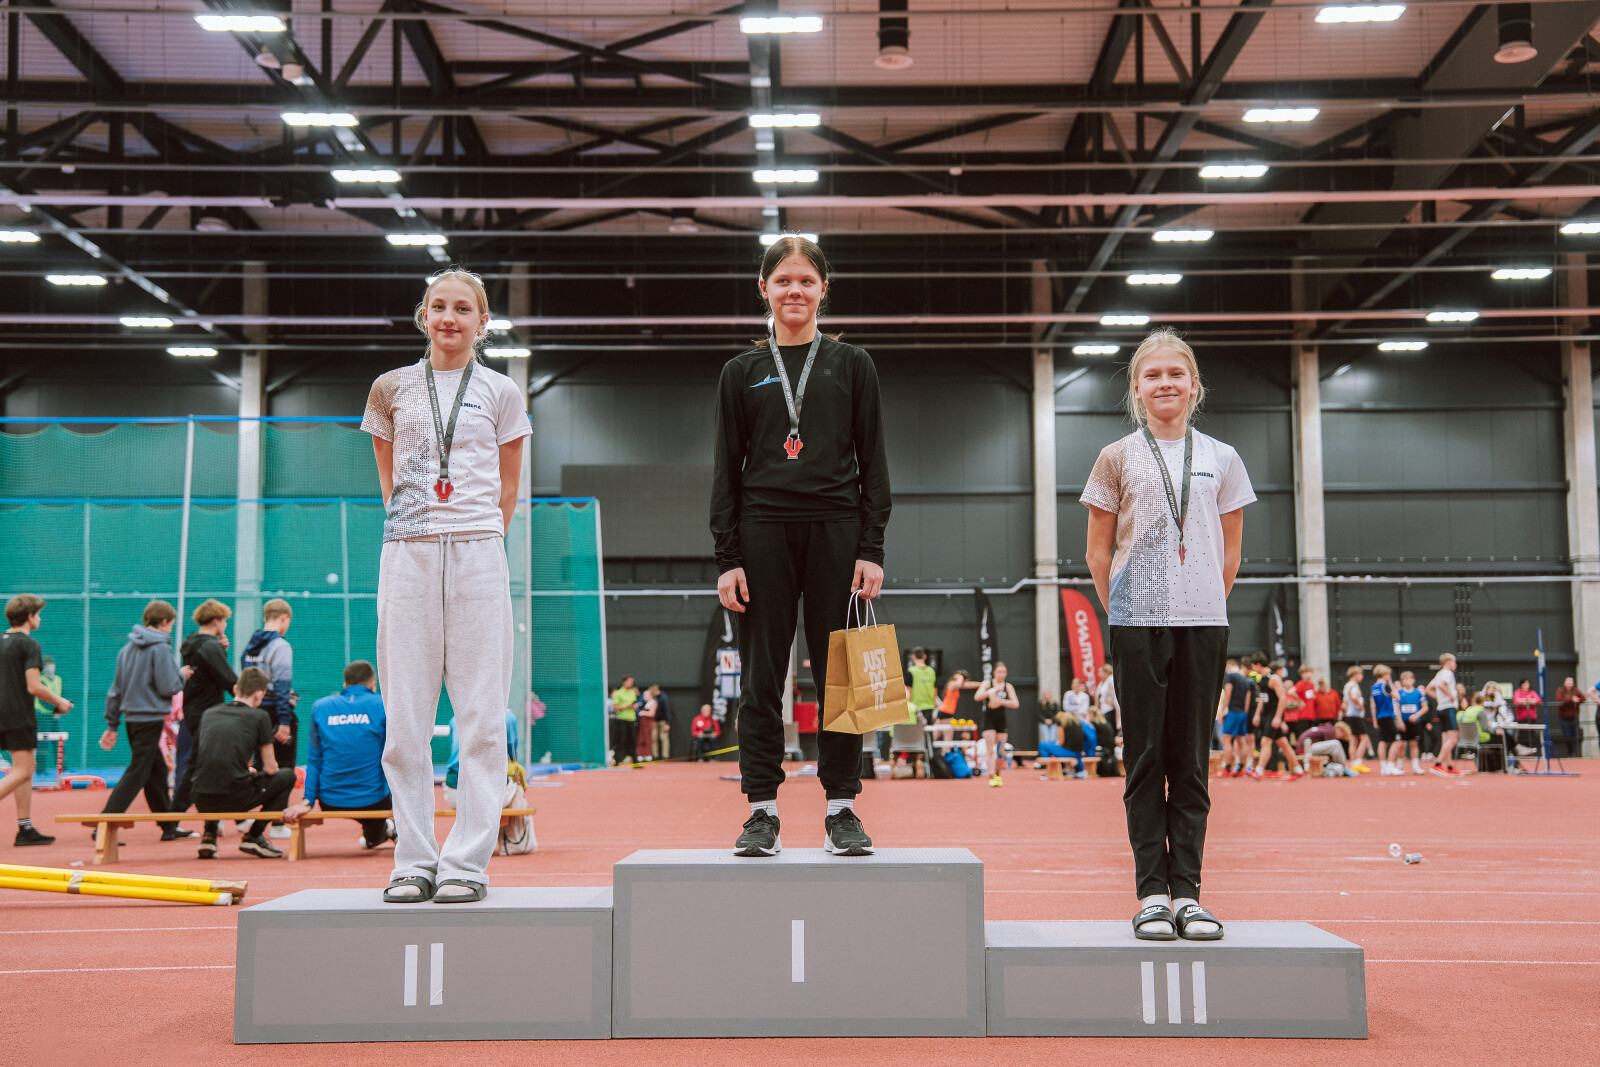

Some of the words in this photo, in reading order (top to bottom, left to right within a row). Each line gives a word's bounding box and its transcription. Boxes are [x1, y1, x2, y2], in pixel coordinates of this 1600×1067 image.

[863, 648, 887, 672] JUST
[869, 669, 887, 691] DO
[327, 713, 370, 726] IECAVA
[1144, 906, 1164, 914] NIKE
[791, 920, 805, 983] I
[404, 942, 444, 1007] II
[1140, 960, 1208, 1025] III
